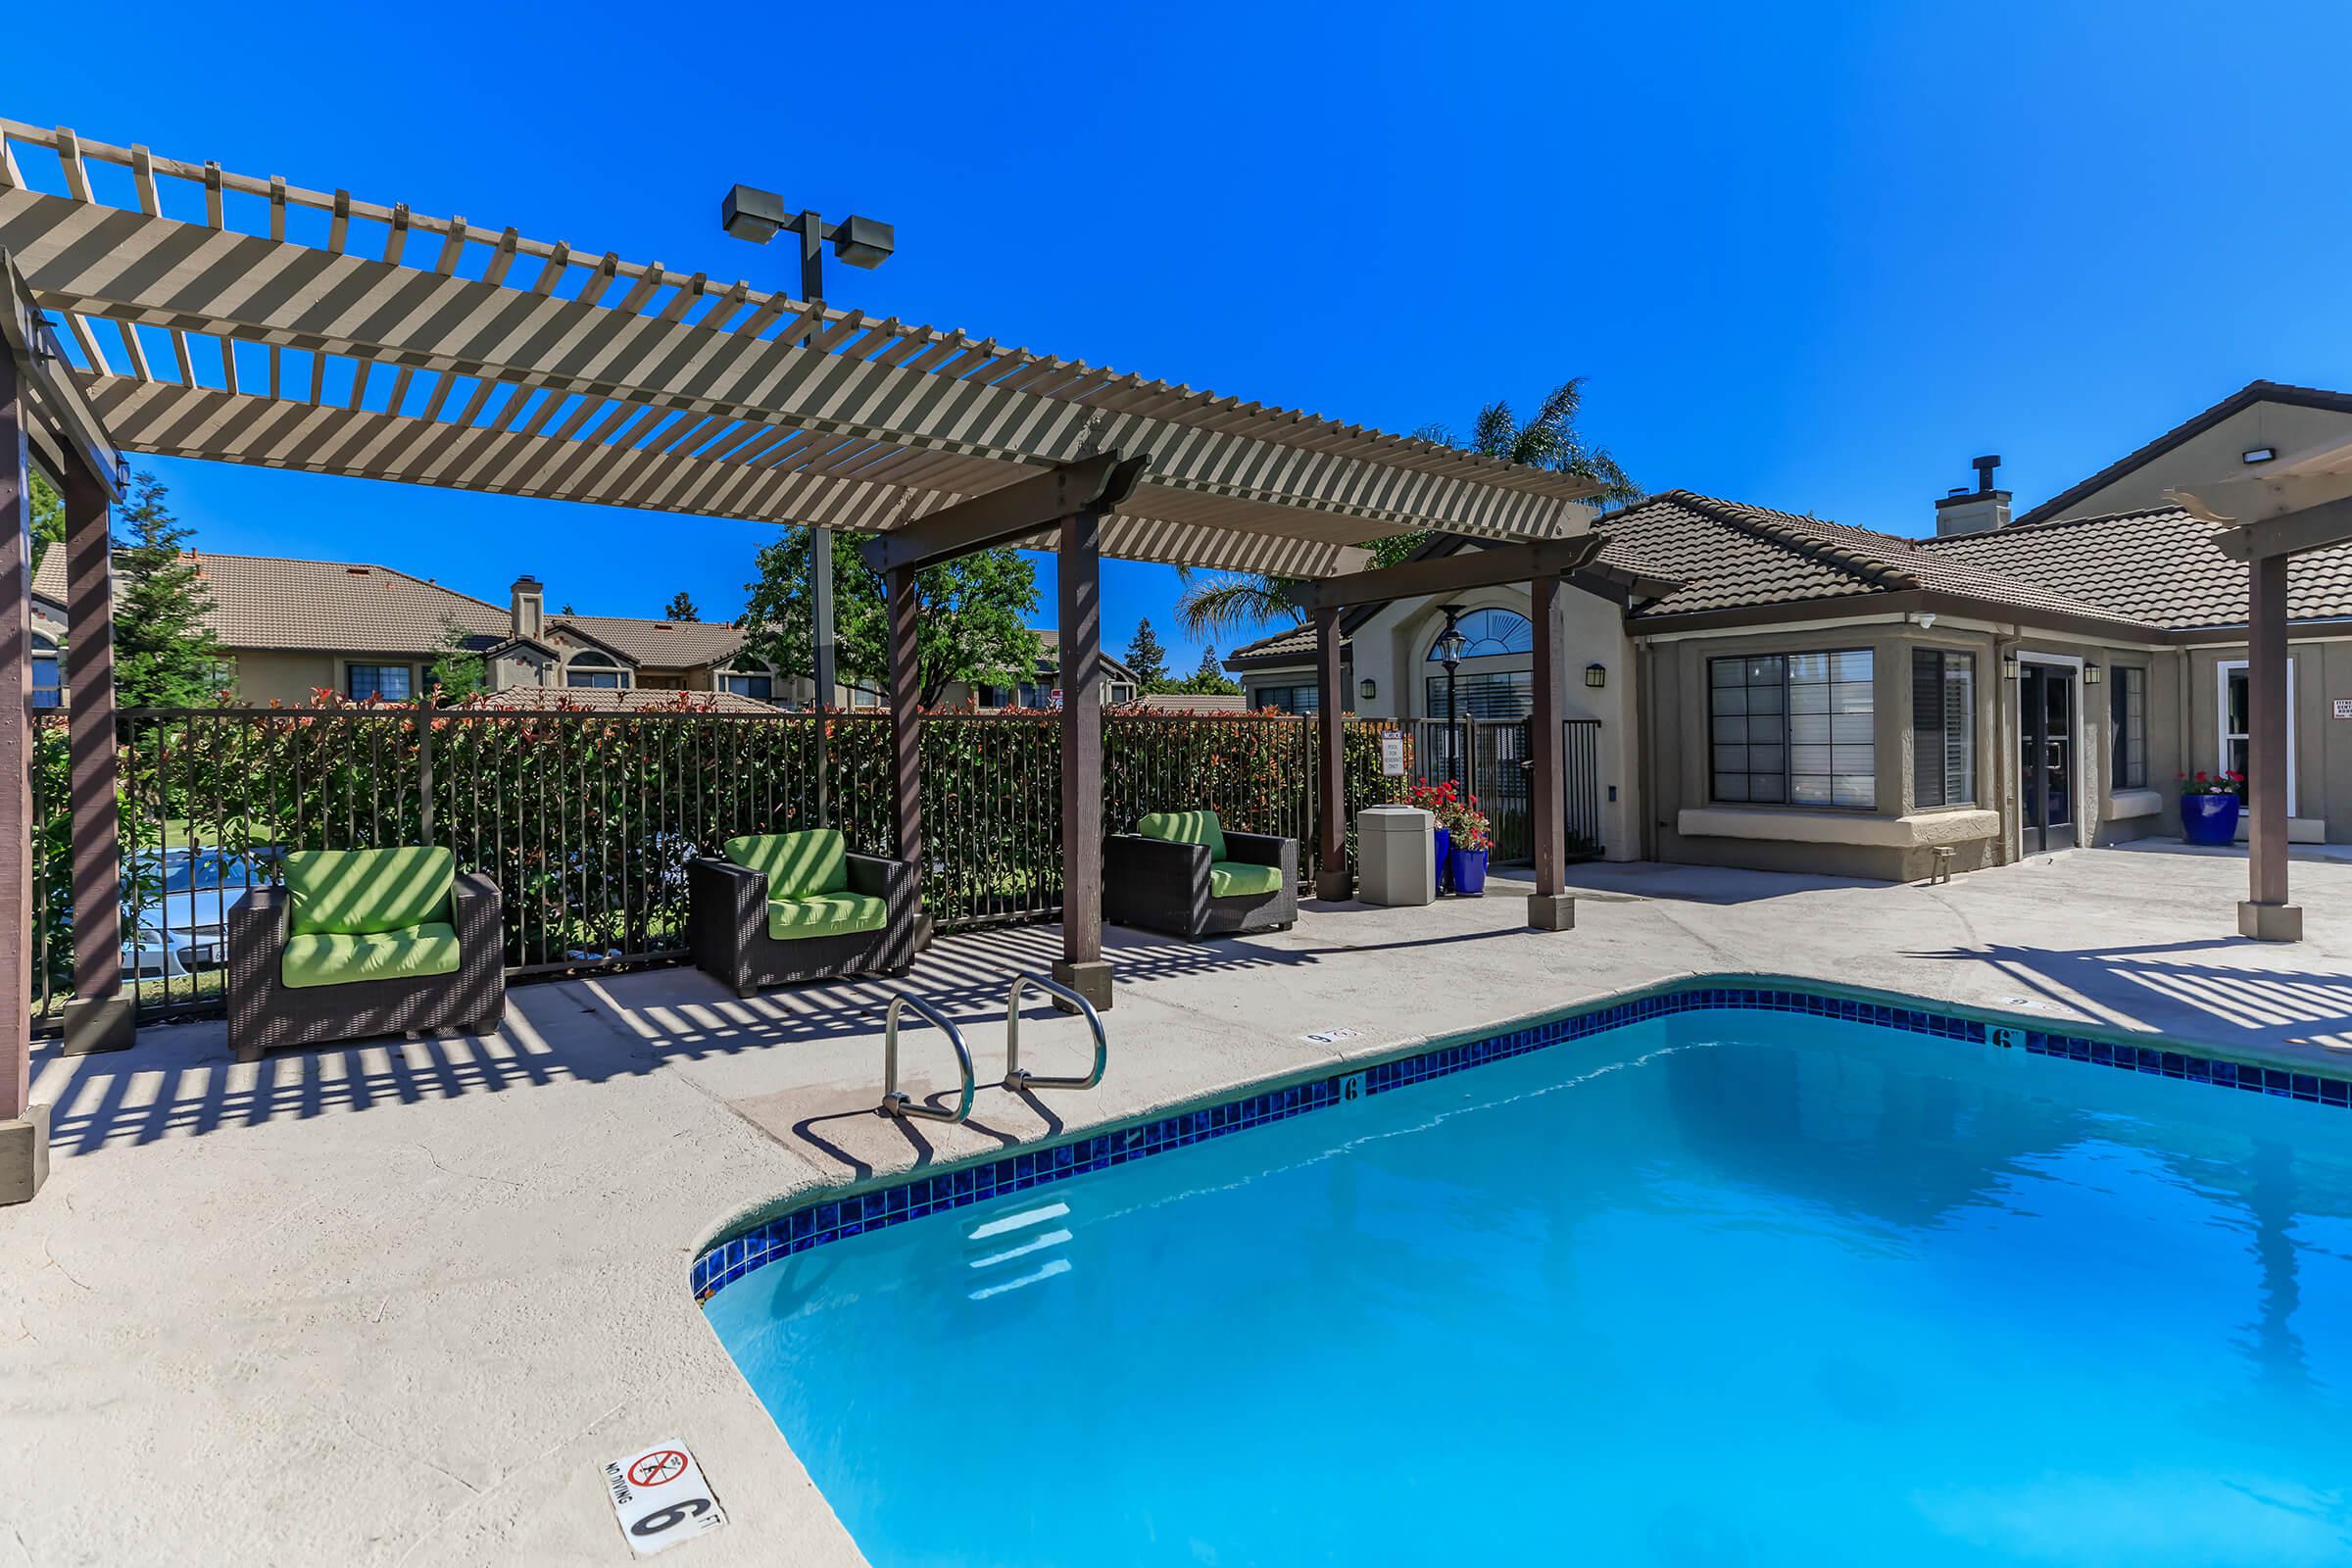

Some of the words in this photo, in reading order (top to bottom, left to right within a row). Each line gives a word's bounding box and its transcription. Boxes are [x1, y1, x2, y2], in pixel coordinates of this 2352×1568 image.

[1992, 1029, 2012, 1049] 6
[1346, 1077, 1358, 1101] 6
[604, 1461, 621, 1476] NO
[610, 1474, 633, 1505] DIVING
[630, 1497, 711, 1537] 6
[697, 1513, 721, 1530] FT
